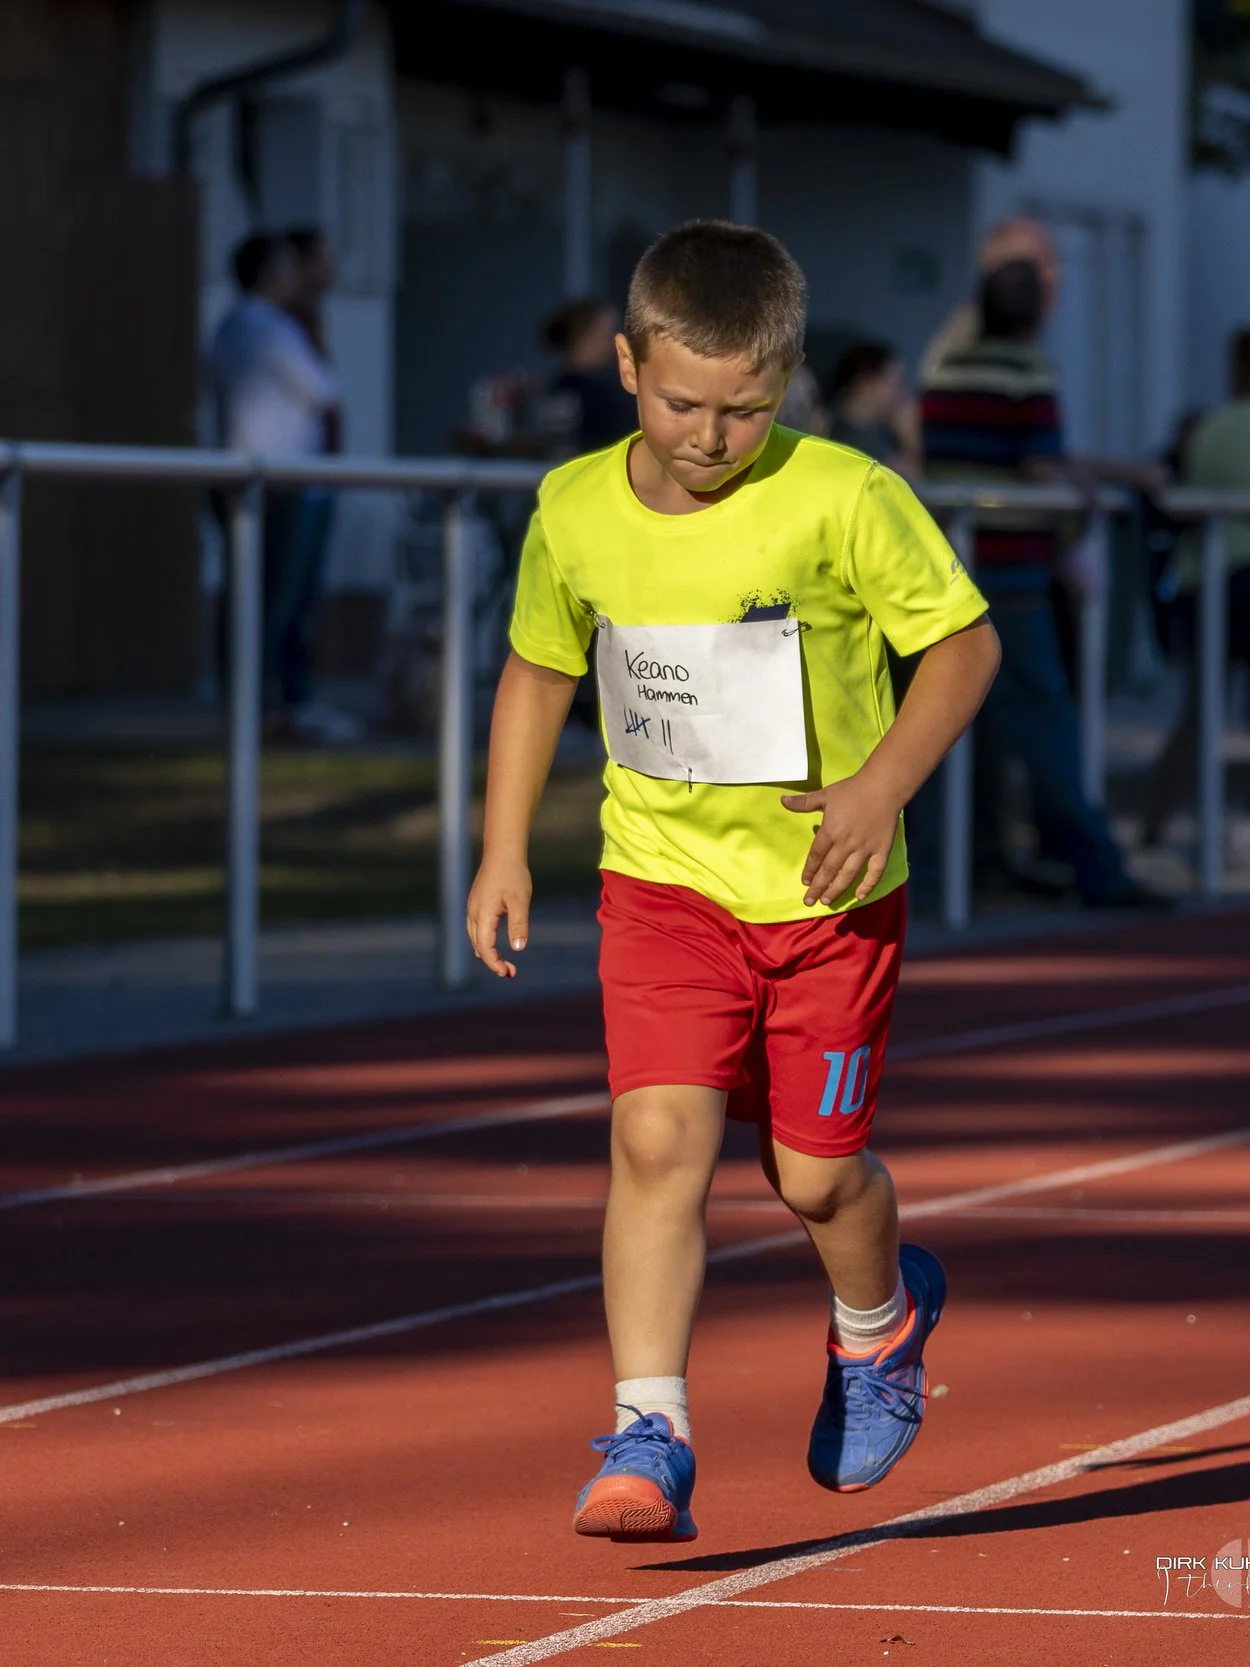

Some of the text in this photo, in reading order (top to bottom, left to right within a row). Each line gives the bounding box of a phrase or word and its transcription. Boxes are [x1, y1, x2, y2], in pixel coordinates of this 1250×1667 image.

[624, 649, 690, 682] Keano
[637, 684, 699, 706] Hammen
[818, 1044, 871, 1117] 10
